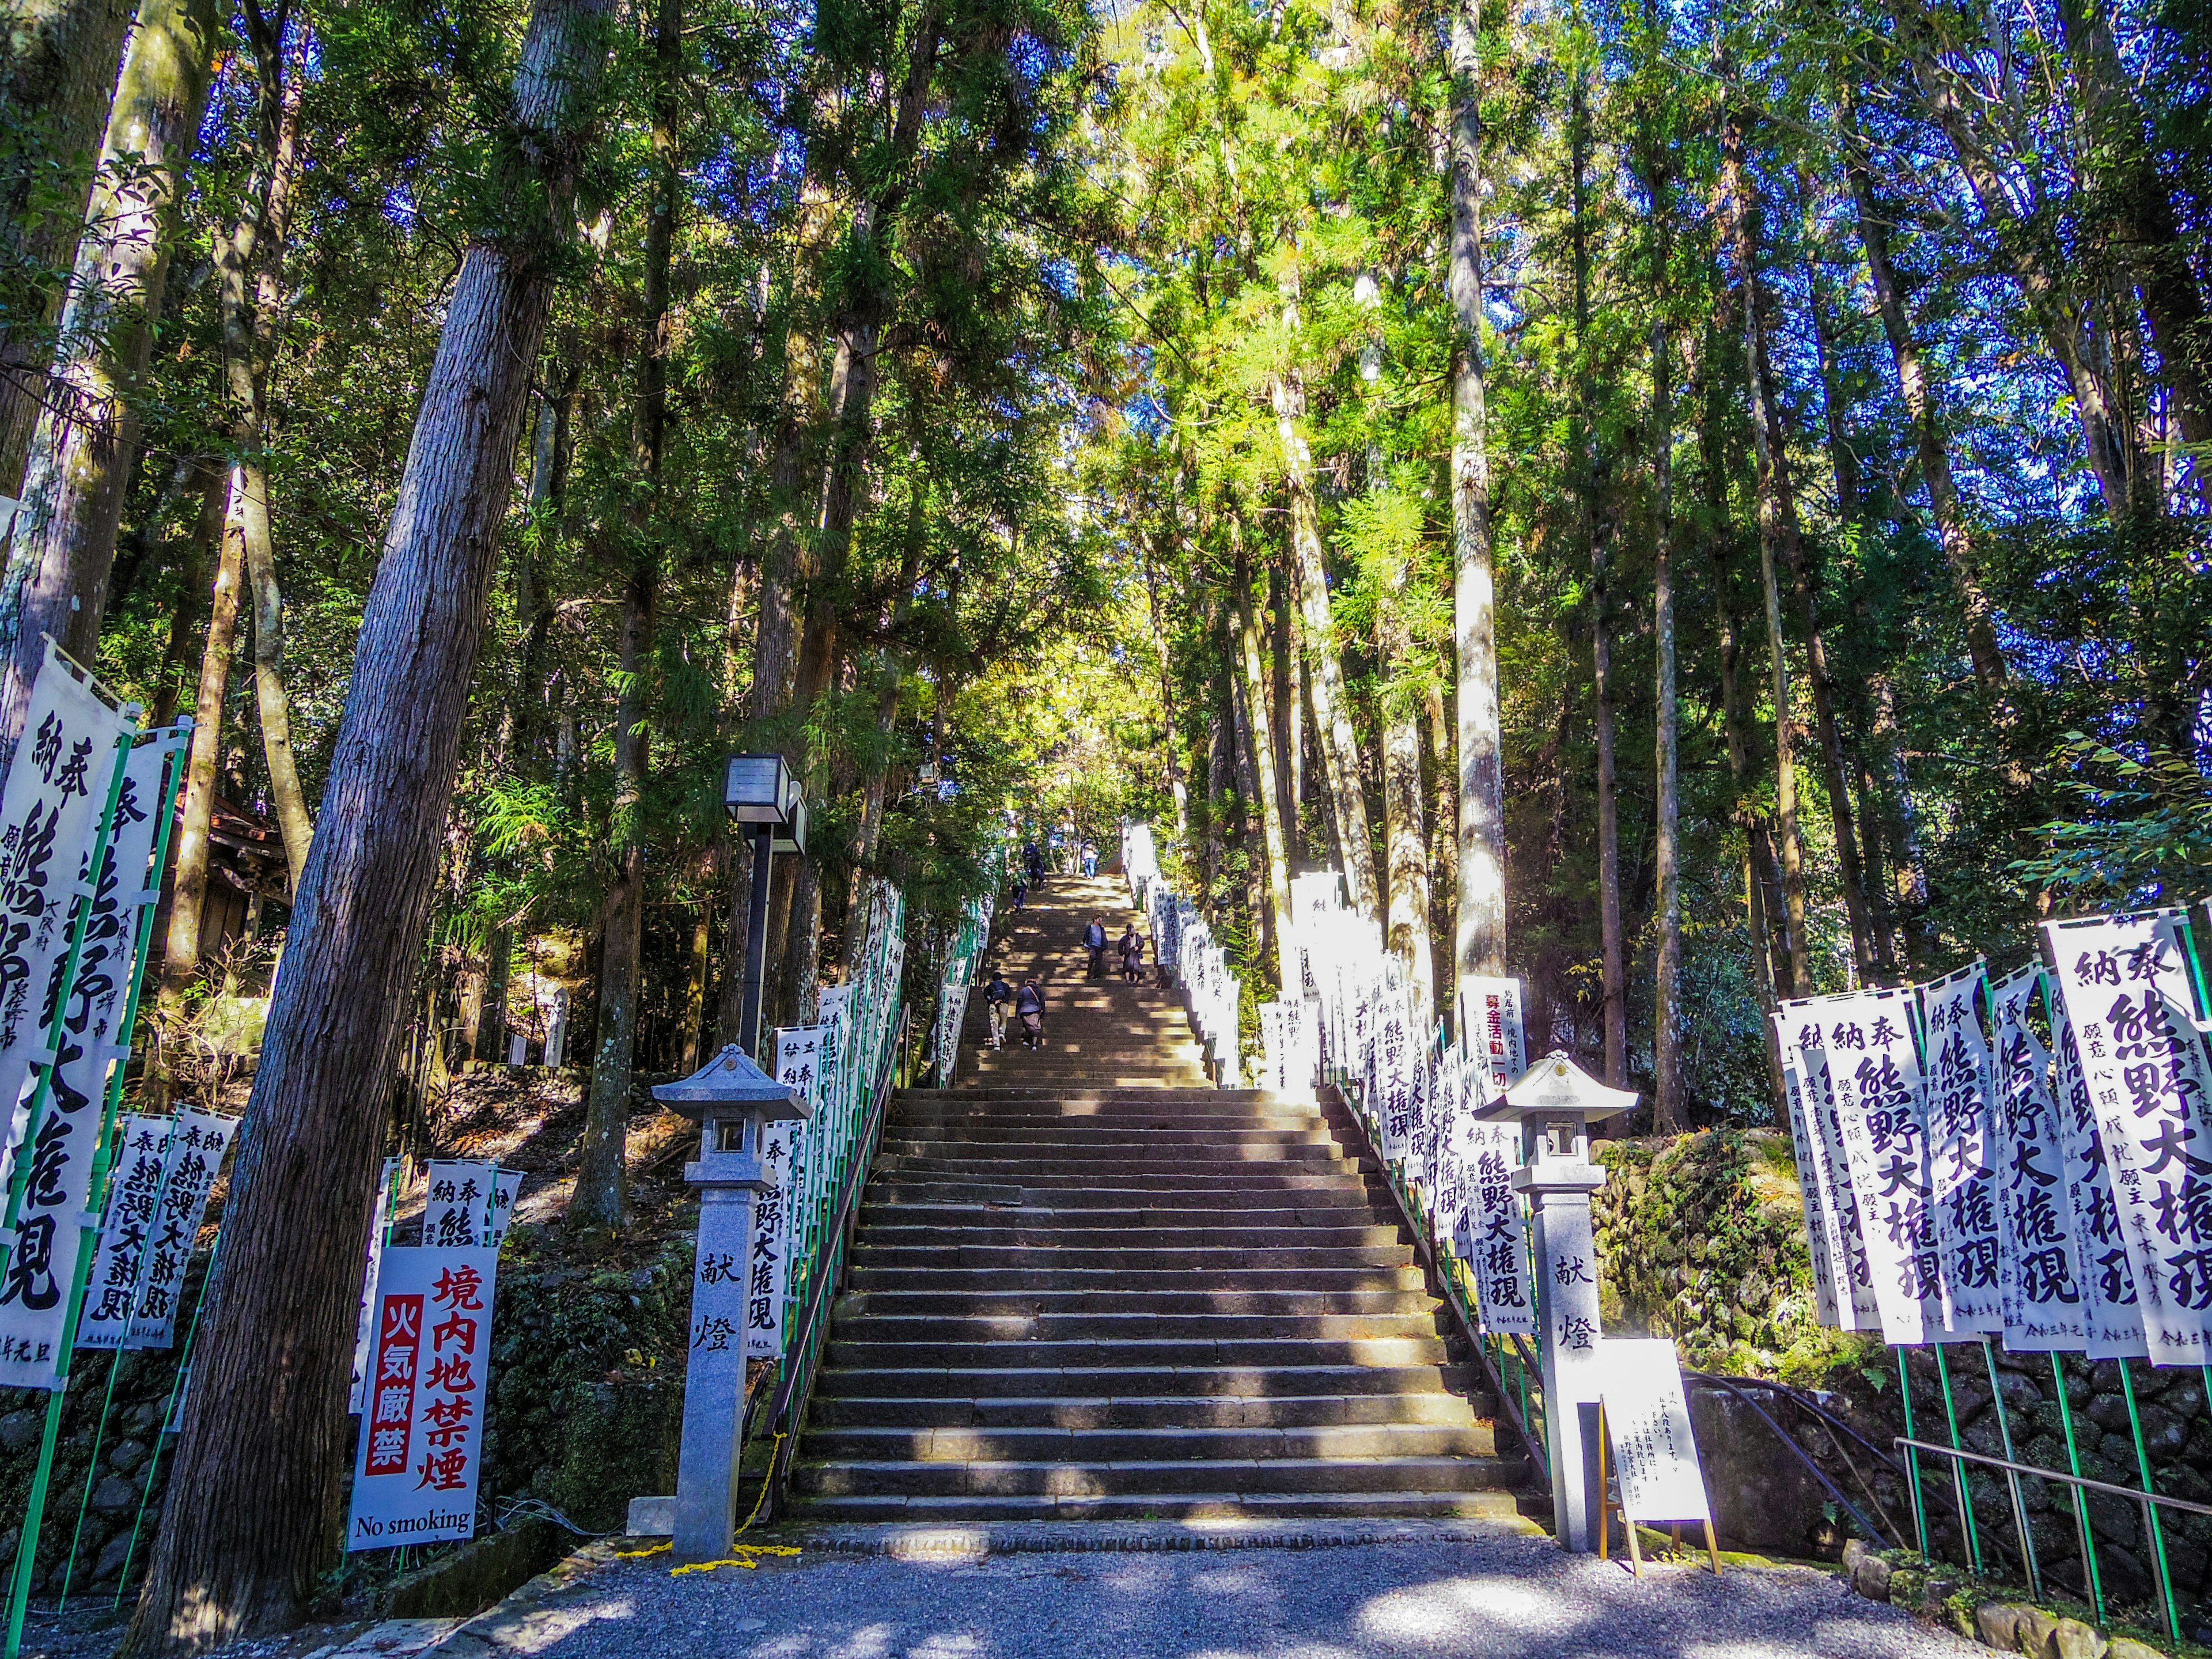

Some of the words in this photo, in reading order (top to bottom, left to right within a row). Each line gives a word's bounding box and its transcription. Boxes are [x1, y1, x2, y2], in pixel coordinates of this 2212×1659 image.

[31, 899, 60, 952] 大阪府
[108, 908, 132, 961] 大阪府
[1485, 994, 1507, 1088] 募金活動一切
[2083, 1023, 2107, 1059] 願意
[2119, 1168, 2146, 1205] 願主
[1478, 1150, 1526, 1308] 熊野大権現
[1854, 1054, 1942, 1301] 熊野大権現
[1939, 1031, 1999, 1289] 熊野大権現
[2001, 1032, 2080, 1304] 熊野大権現
[2106, 990, 2212, 1310] 熊野大権現
[412, 1264, 484, 1492] 境内地禁煙
[692, 1253, 741, 1352] 献燈
[1555, 1255, 1598, 1350] 献燈
[372, 1302, 417, 1467] 火気厳禁
[355, 1516, 383, 1538] No
[388, 1509, 470, 1535] smoking
